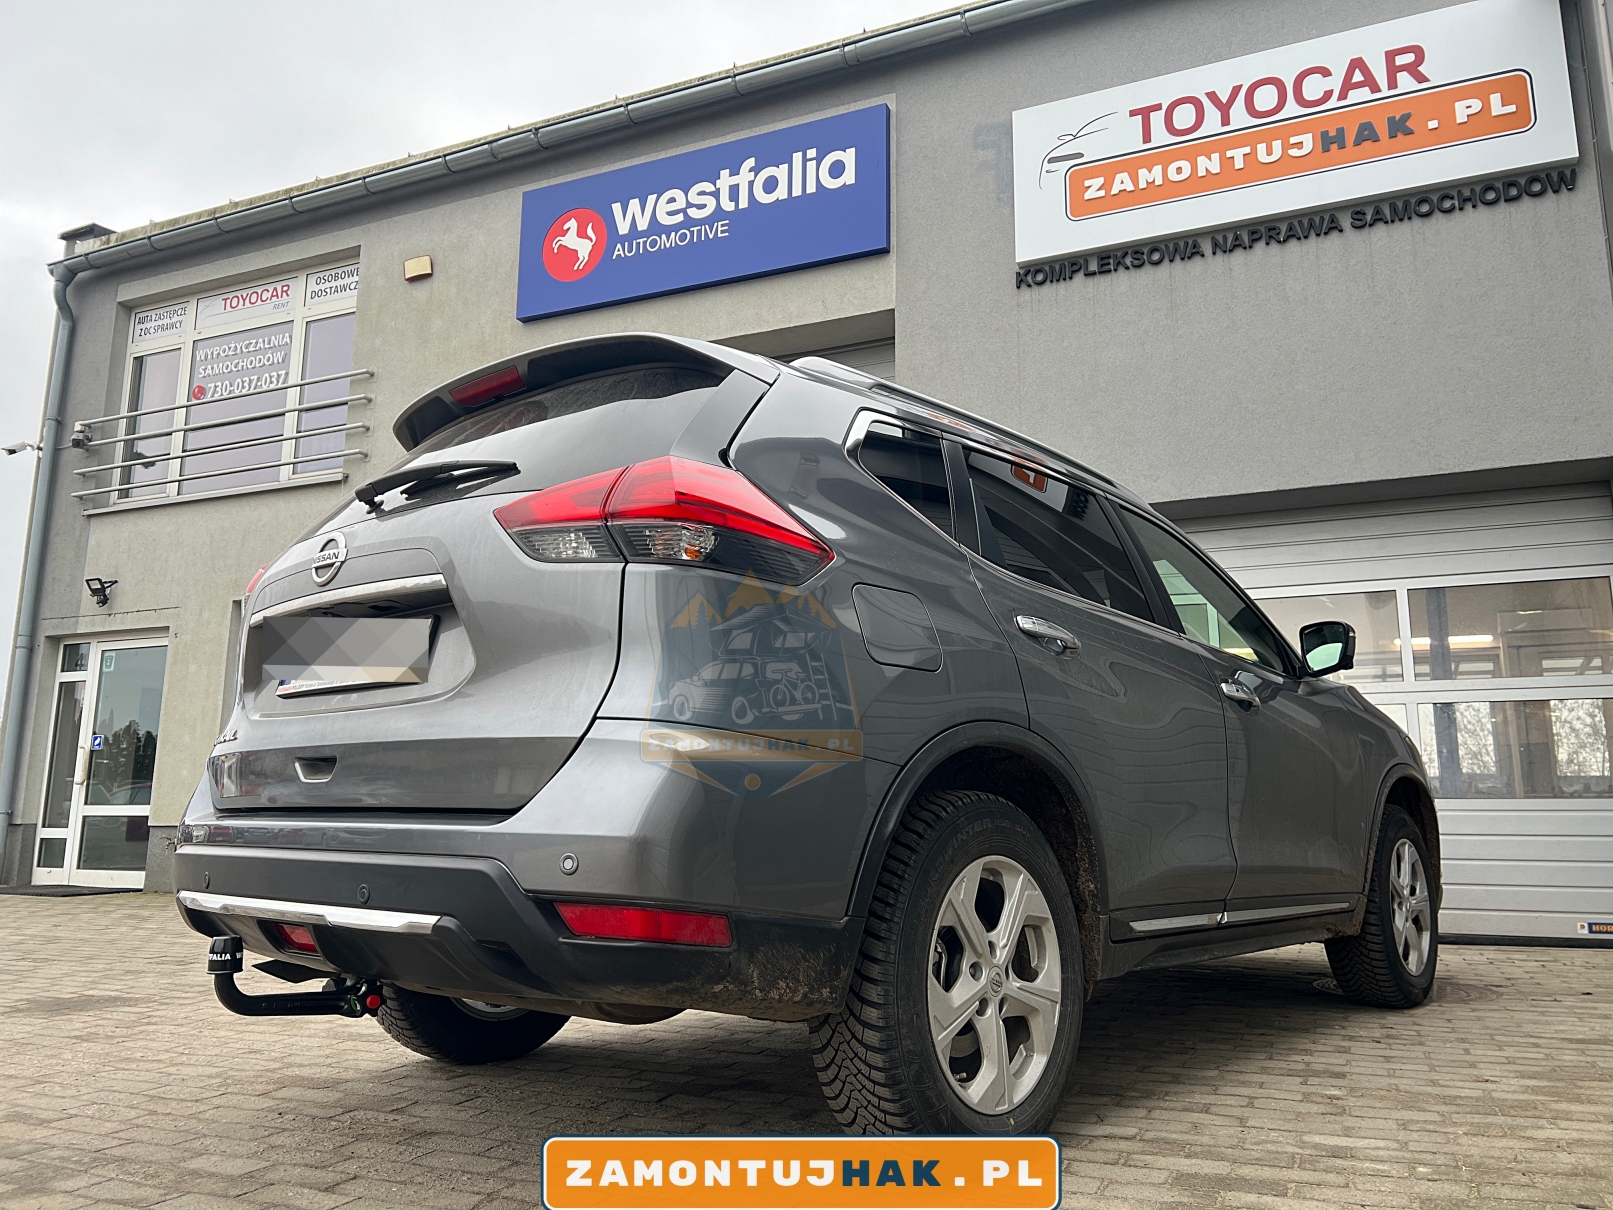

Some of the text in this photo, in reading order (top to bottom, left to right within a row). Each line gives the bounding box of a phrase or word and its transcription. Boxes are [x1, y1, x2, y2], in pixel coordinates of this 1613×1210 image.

[1128, 43, 1432, 145] TOYOCAR
[610, 146, 857, 236] westfalia
[612, 219, 730, 260] AUTOMOTIVE
[1015, 238, 1205, 289] KOMPLEKSOWA
[1210, 212, 1344, 255] NAPRAWA
[221, 283, 291, 311] TOYOCAR
[272, 301, 290, 310] RENT
[137, 306, 188, 326] AUTA ZASTĘPCZE
[139, 319, 183, 337] Z OC SPRAWCY
[196, 332, 291, 361] WYPOŻYCZALNIA
[198, 350, 285, 378] SAMOCHODÓW
[207, 369, 286, 399] 730-037-037
